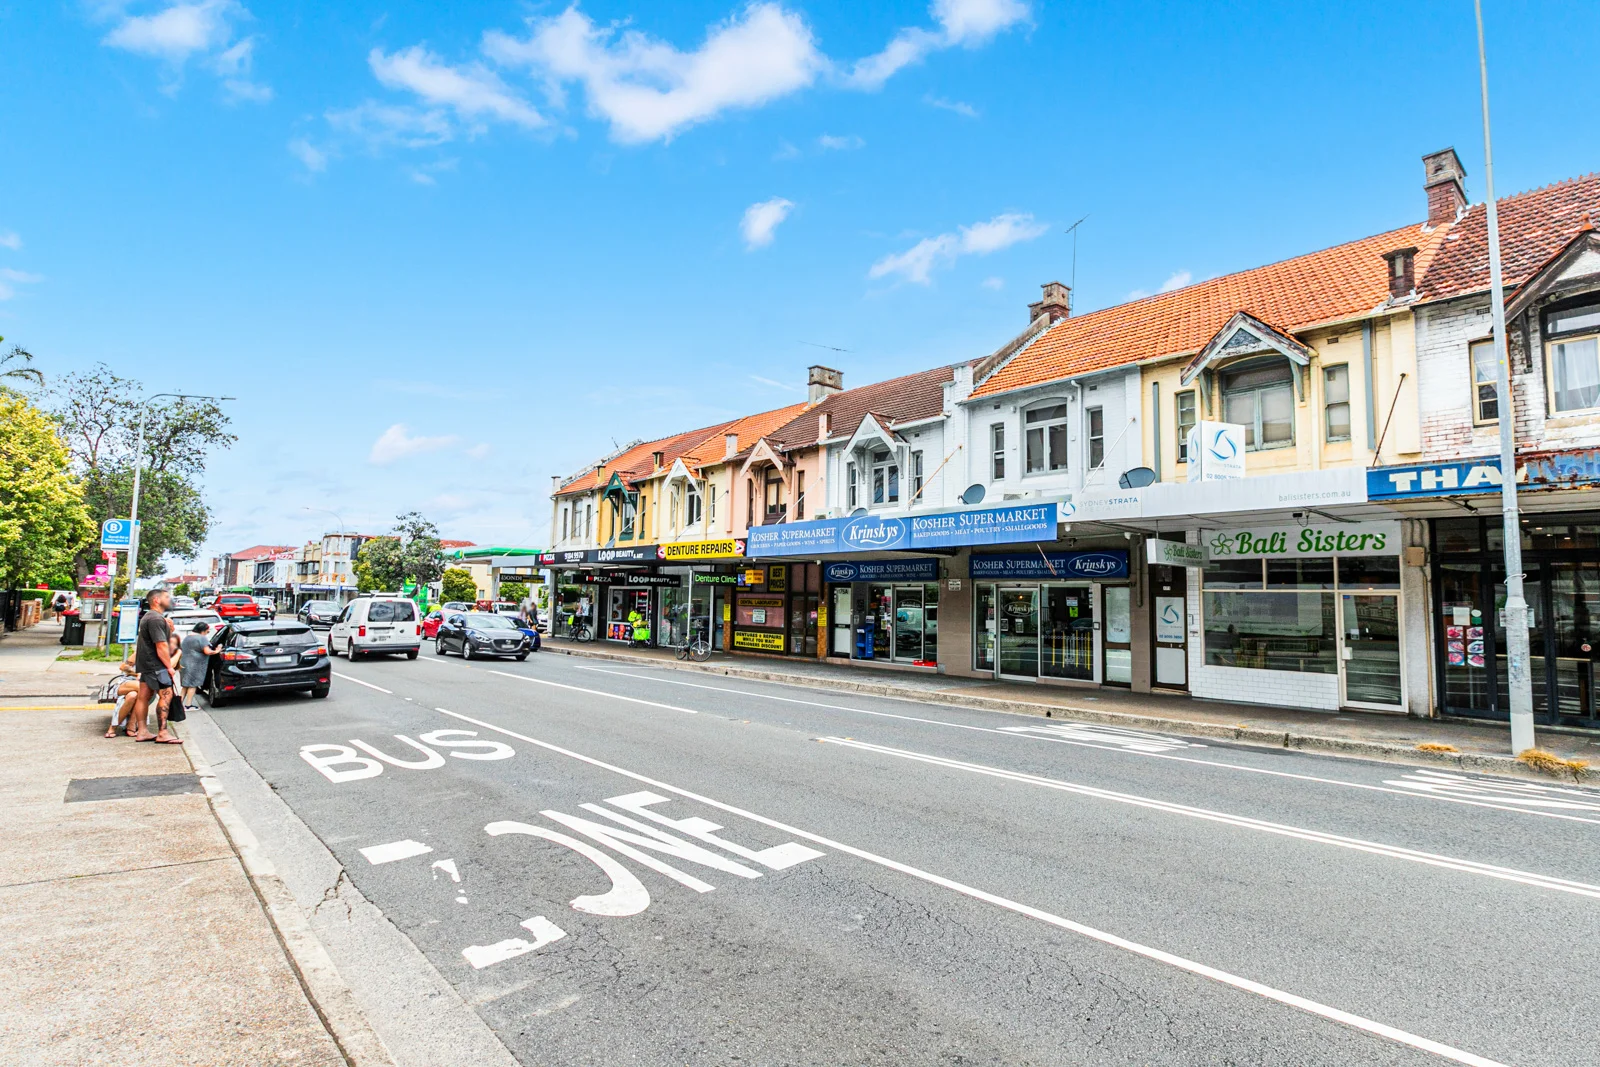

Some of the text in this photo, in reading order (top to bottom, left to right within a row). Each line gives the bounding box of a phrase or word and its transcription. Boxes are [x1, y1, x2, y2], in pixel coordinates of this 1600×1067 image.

[913, 508, 1048, 530] KOSHER SUPERMARKET
[850, 523, 898, 544] Krinskys
[1004, 523, 1048, 532] SMALLGOODS
[751, 527, 836, 542] KOSHER SUPERMARKET
[1235, 528, 1386, 554] Bali Sisters
[598, 550, 615, 560] LOOP
[668, 543, 732, 556] DENTURE REPAIRS
[1172, 544, 1202, 559] Bali Sisters
[860, 564, 932, 574] KOSHER SUPERMARKET
[973, 560, 1004, 570] KOSHER
[1075, 559, 1116, 573] Krinskys
[695, 574, 720, 583] Denture
[720, 575, 736, 583] Clinic
[772, 568, 782, 577] BEST
[830, 568, 854, 578] Krinskys
[300, 730, 516, 783] BUS
